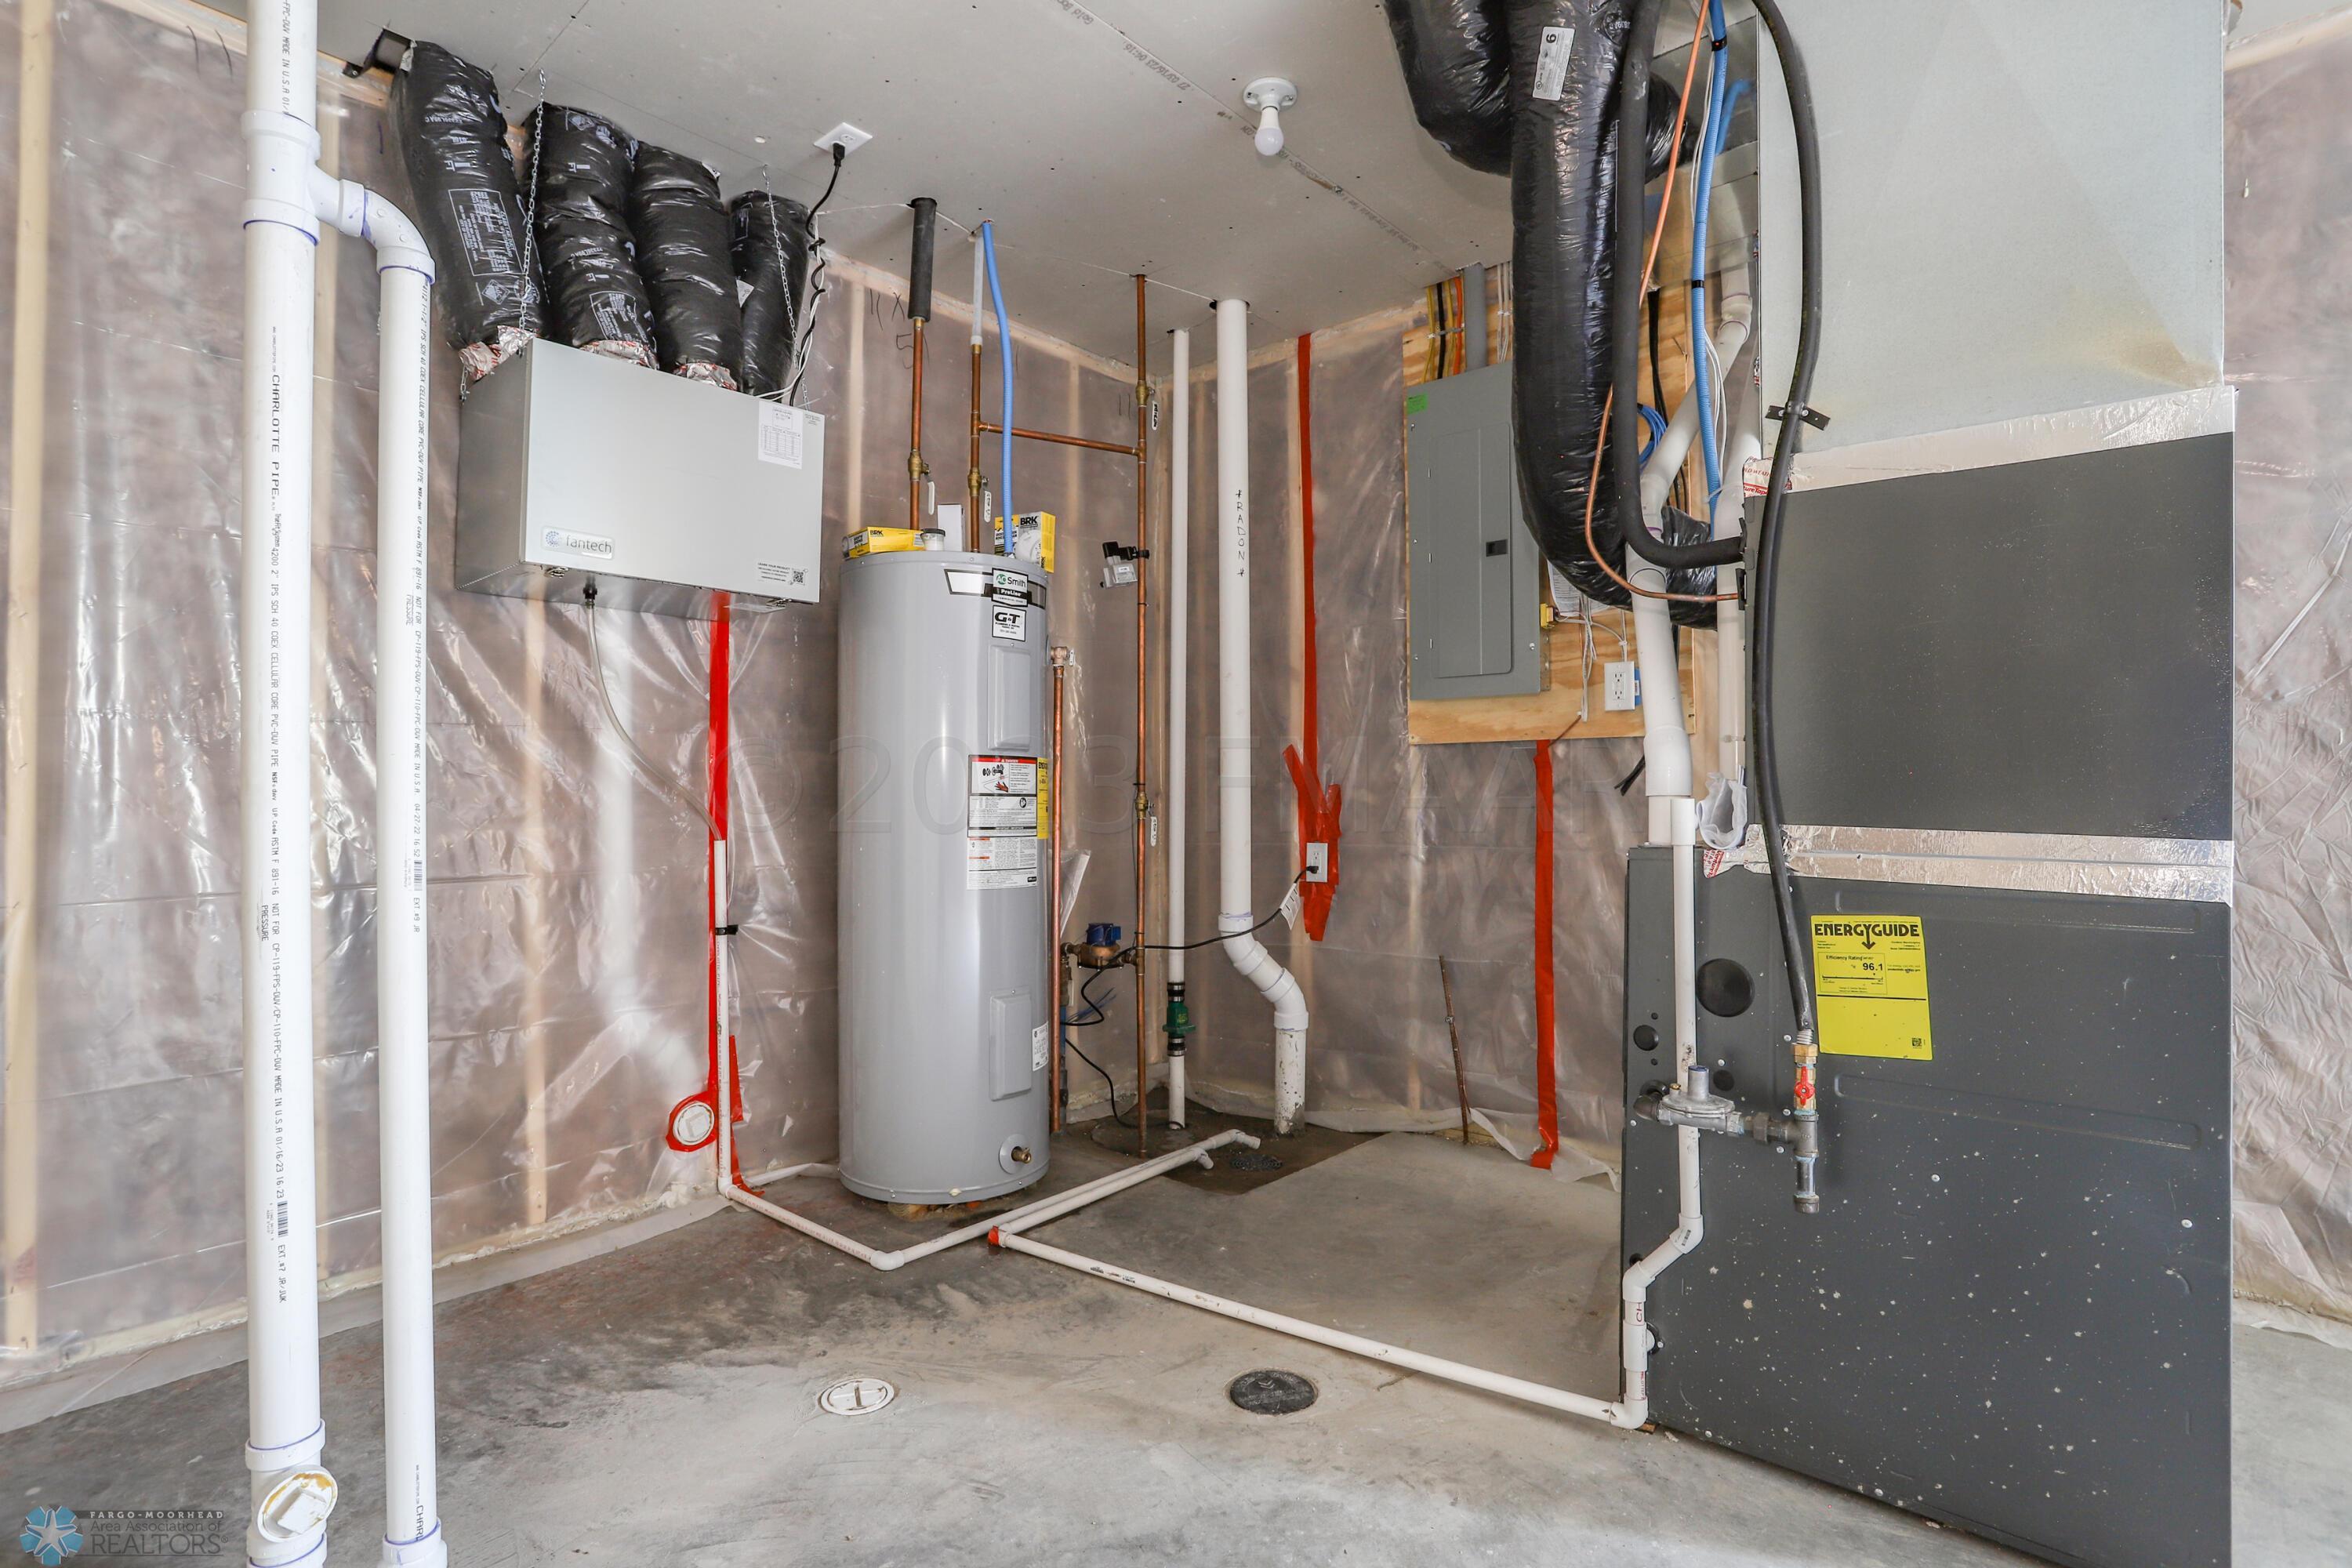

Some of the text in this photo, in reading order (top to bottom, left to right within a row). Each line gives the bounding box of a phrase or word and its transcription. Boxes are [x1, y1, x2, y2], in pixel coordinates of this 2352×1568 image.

[1071, 9, 1094, 24] Gold
[282, 59, 290, 67] IN
[272, 375, 280, 452] CHARLOTTE
[272, 462, 280, 496] PIPE
[1020, 515, 1038, 526] BRK
[1237, 501, 1246, 560] RADON
[566, 535, 612, 554] fantech
[1007, 576, 1026, 588] Smith
[271, 618, 279, 627] 40
[995, 612, 1020, 624] G&T
[1815, 924, 1920, 938] ENERGYGUIDE
[1862, 963, 1883, 972] 96.1
[275, 1098, 282, 1107] IN
